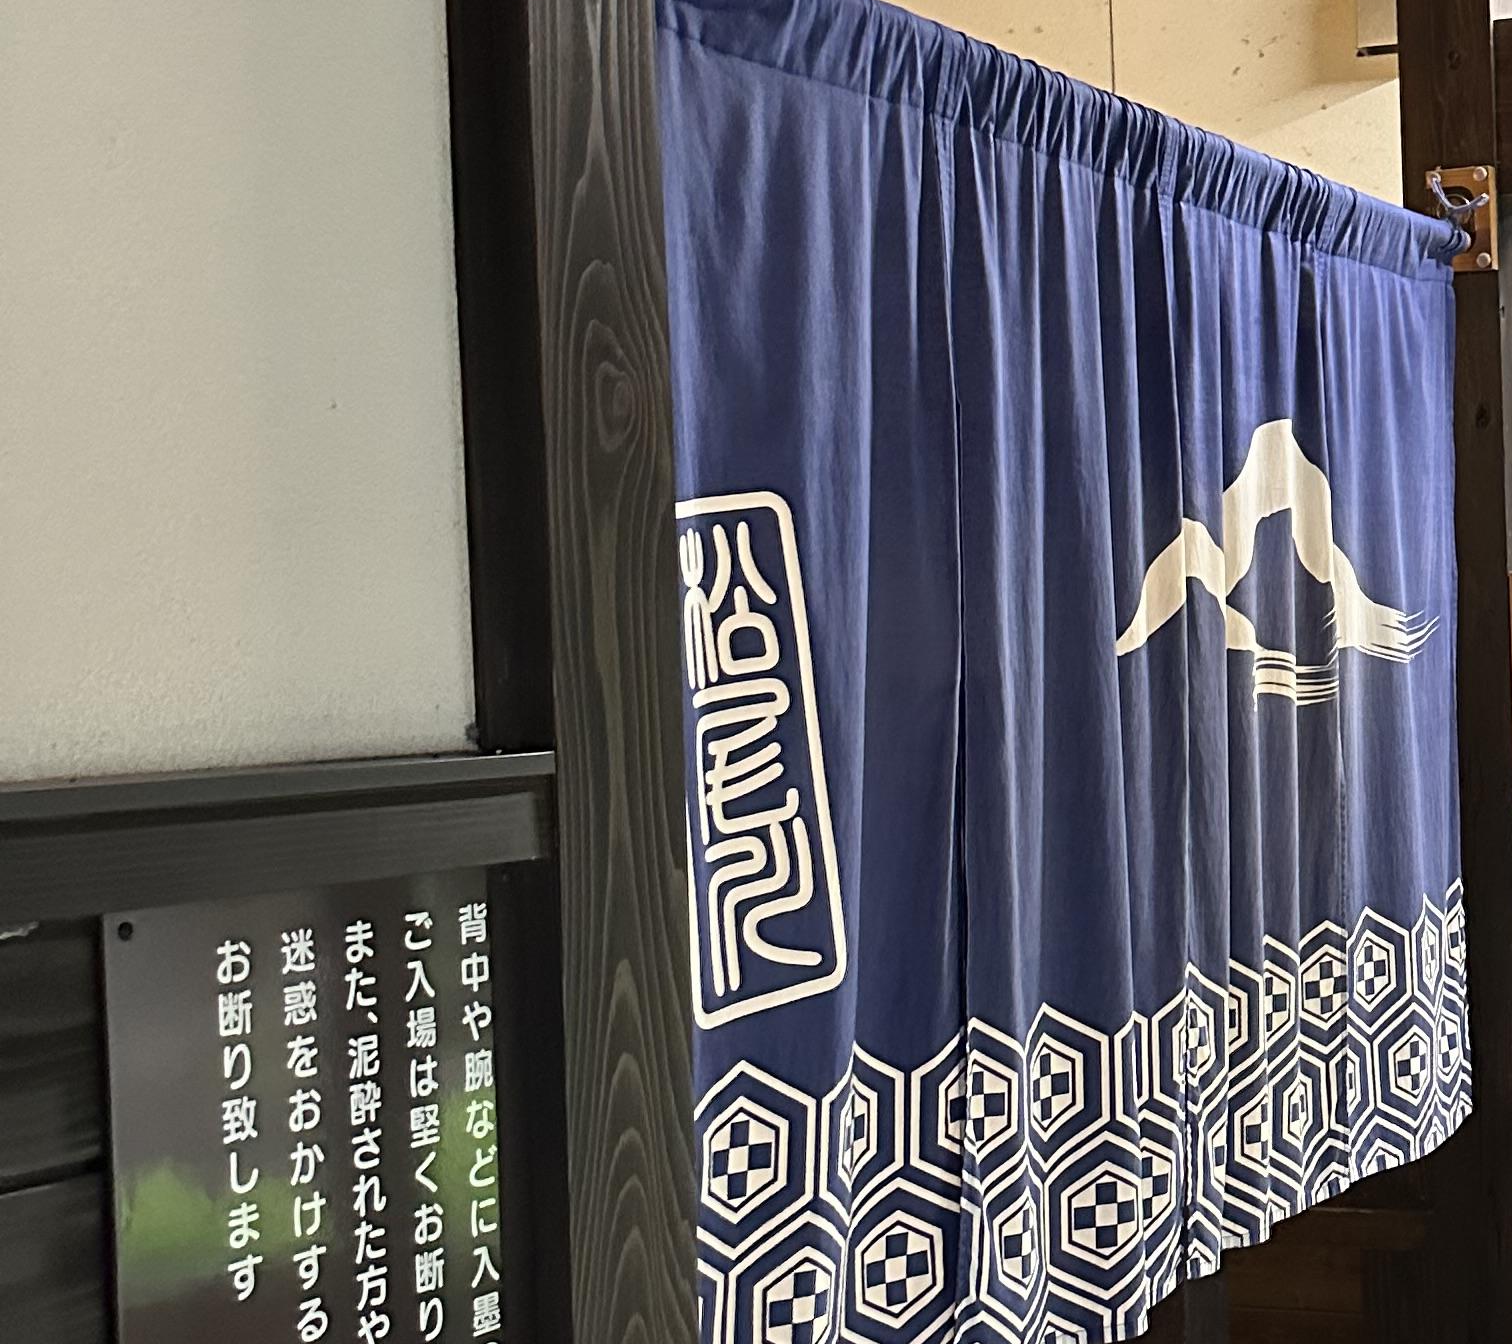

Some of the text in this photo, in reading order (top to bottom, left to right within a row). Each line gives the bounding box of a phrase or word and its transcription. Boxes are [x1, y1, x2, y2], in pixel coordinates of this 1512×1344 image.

[217, 940, 263, 1300] お断り致します
